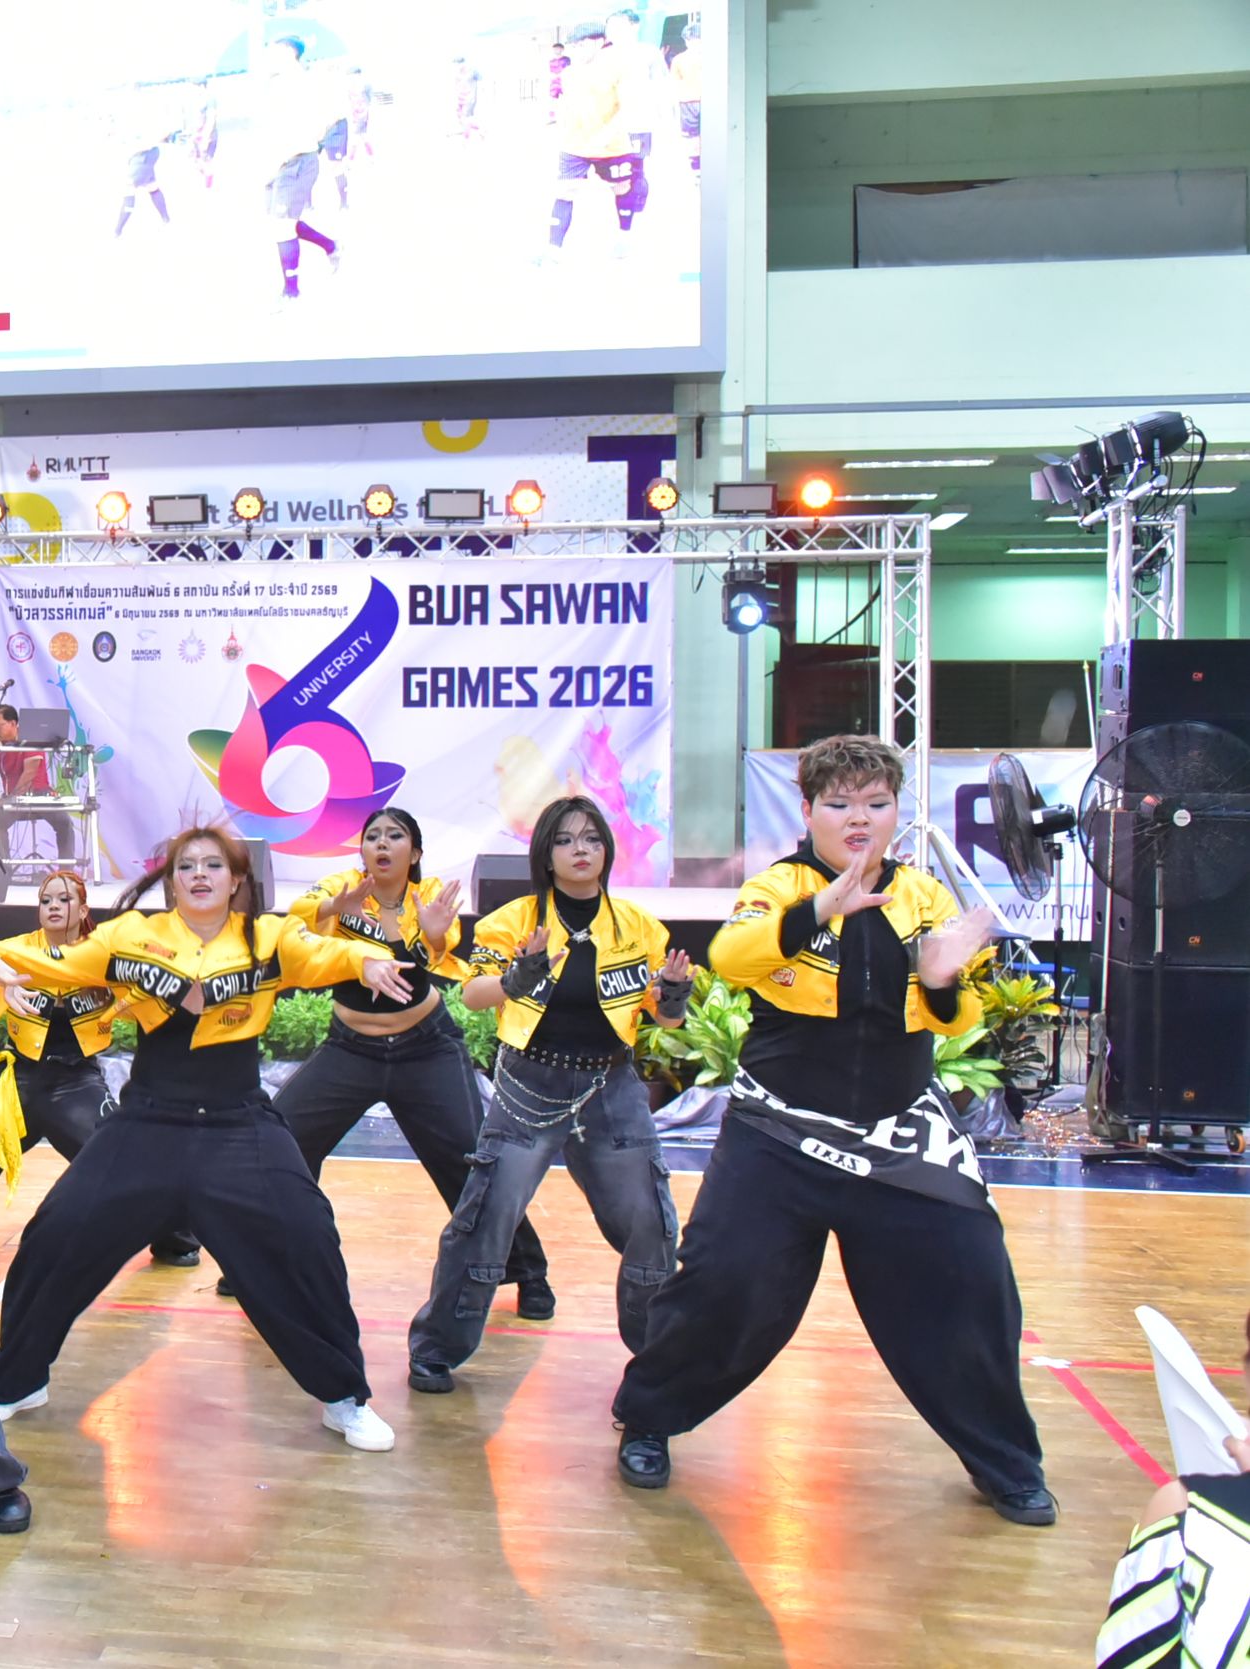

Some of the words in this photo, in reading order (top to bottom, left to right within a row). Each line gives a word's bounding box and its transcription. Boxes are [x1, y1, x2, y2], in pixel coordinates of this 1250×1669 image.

[45, 456, 110, 473] RMUTT
[287, 499, 409, 522] Wellns
[174, 587, 180, 597] 6
[183, 584, 219, 597] สถาบัน
[222, 580, 251, 597] ครั้งที่
[254, 586, 265, 596] 17
[269, 582, 308, 596] ประจำปี
[311, 585, 338, 596] 2569
[159, 609, 179, 618] 2569
[408, 584, 489, 626] BUA
[500, 581, 649, 625] SAWAN
[293, 630, 373, 706] UNIVERSITY
[402, 666, 539, 708] GAMES
[550, 664, 654, 708] 2026
[155, 972, 181, 998] UP
[599, 968, 641, 996] CHILL
